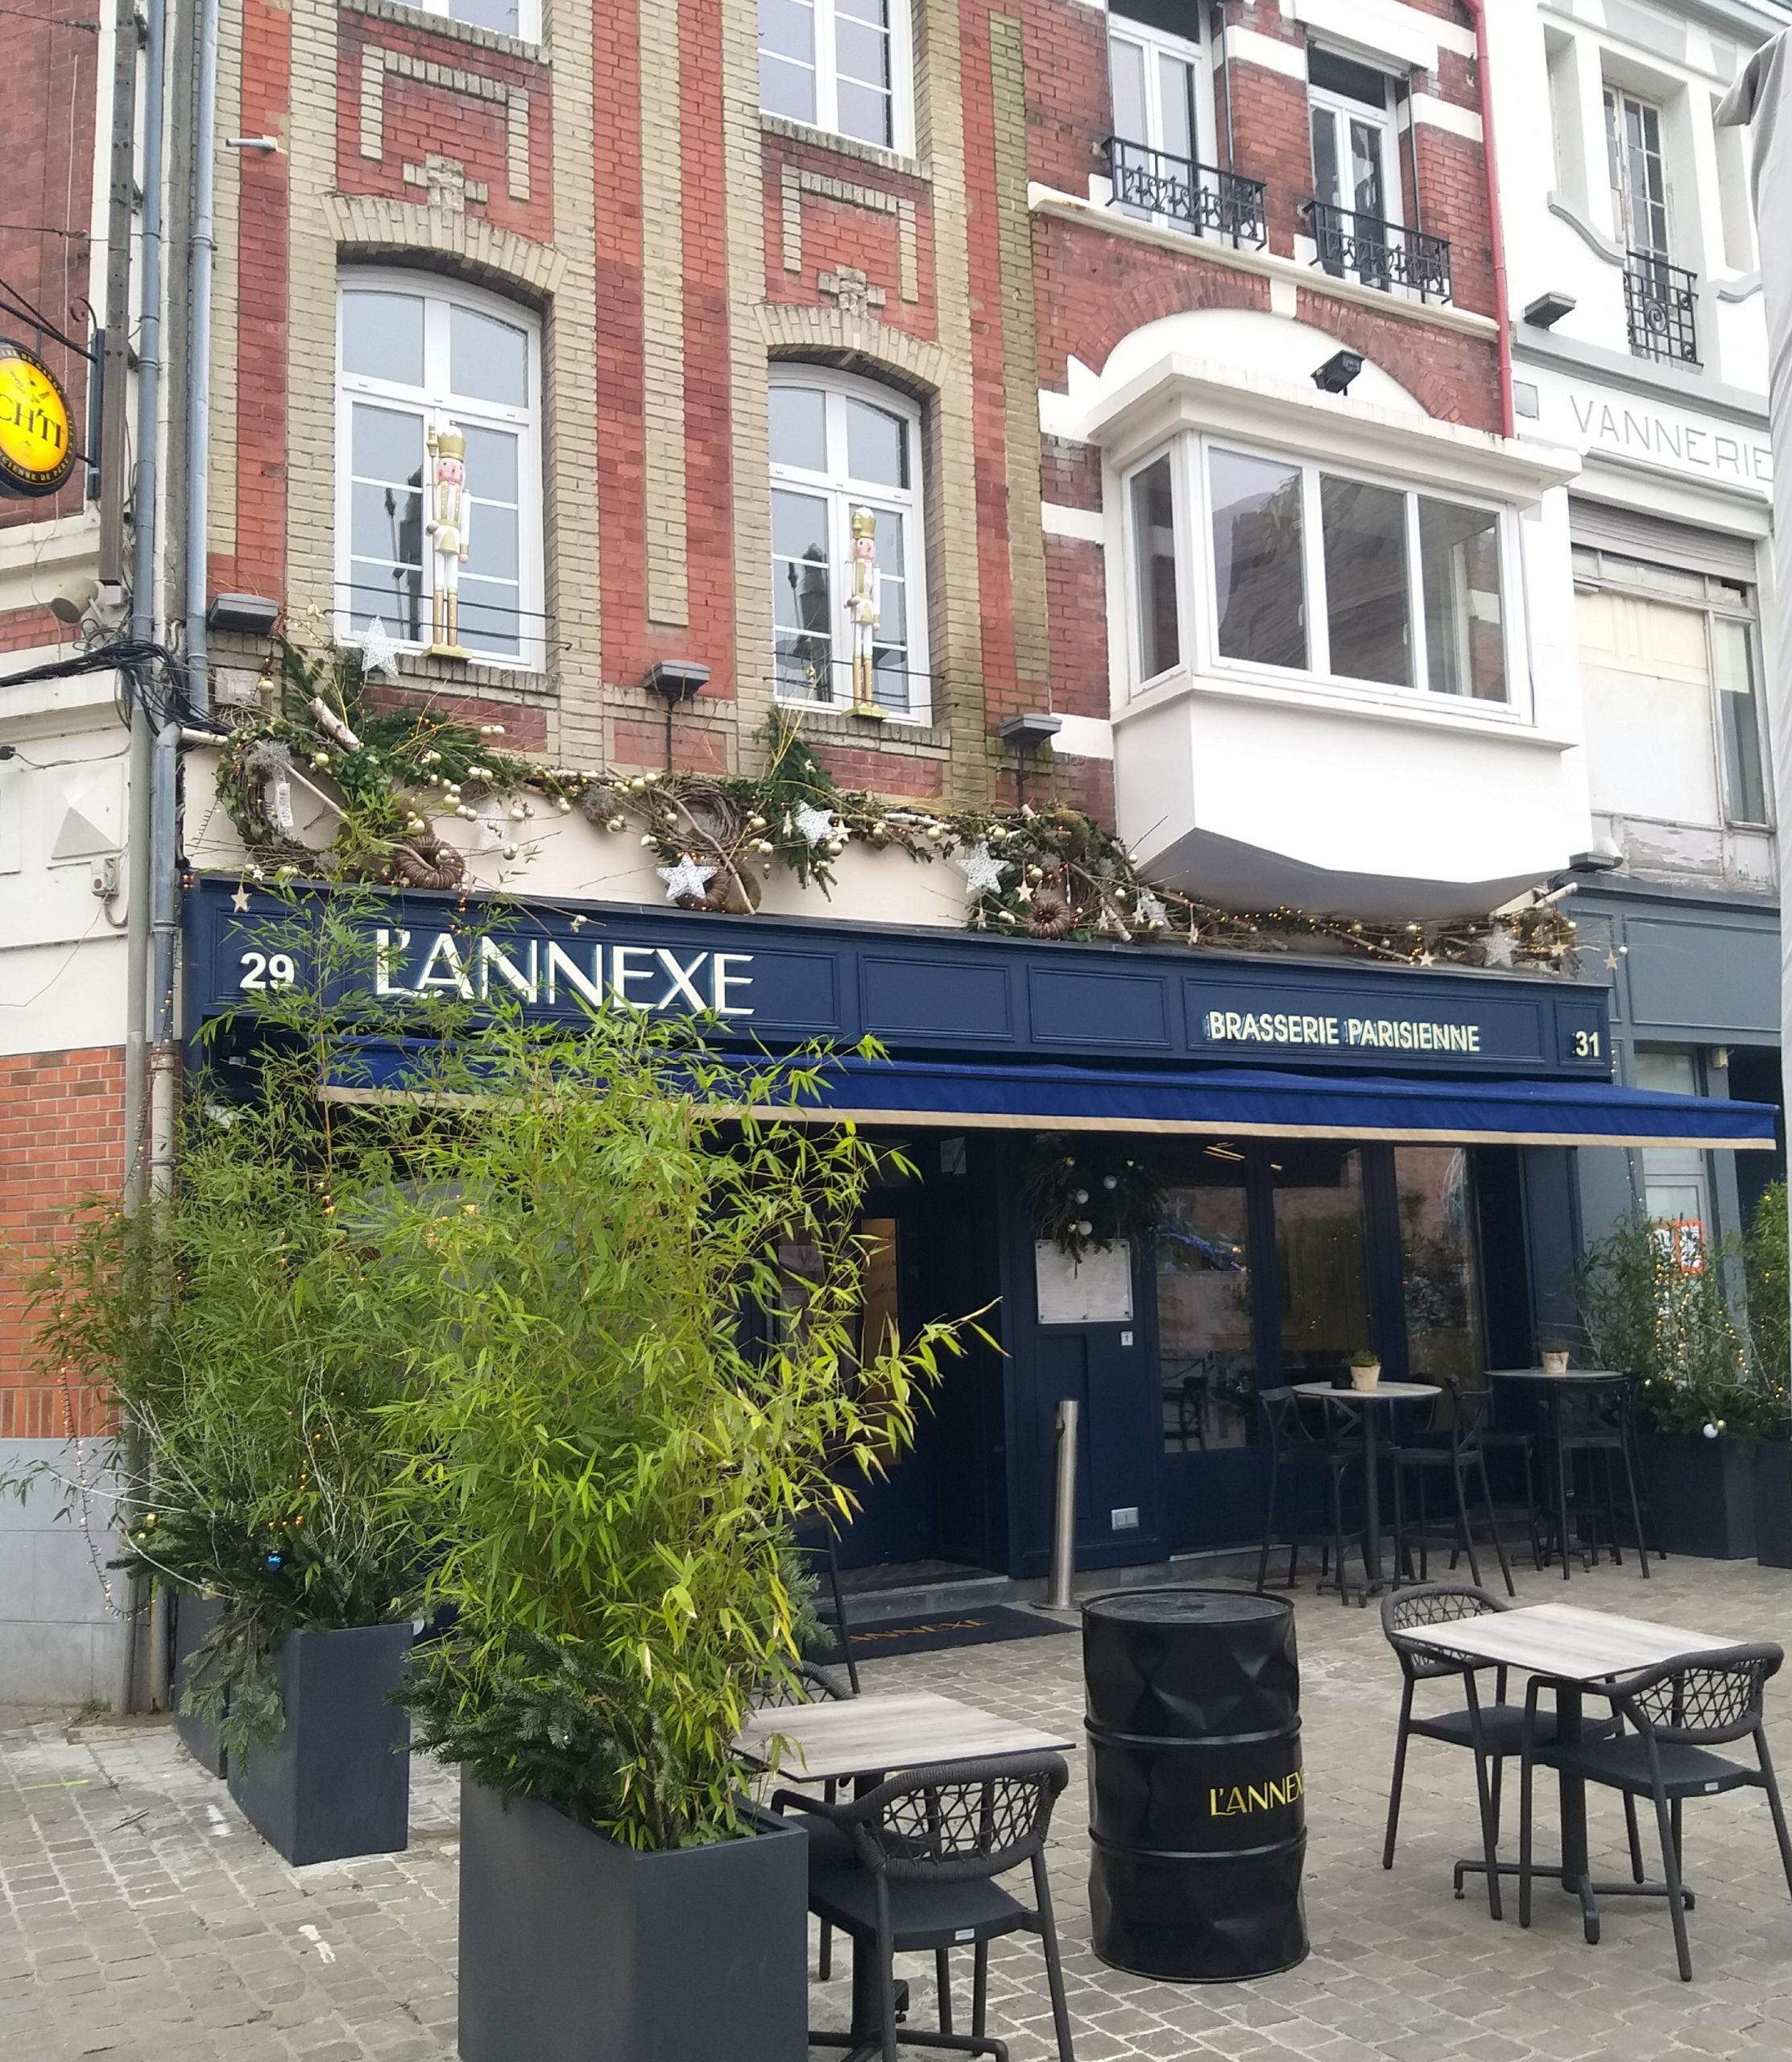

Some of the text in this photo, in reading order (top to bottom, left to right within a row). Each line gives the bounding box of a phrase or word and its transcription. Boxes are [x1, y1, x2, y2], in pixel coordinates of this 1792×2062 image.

[1570, 395, 1773, 482] VANNERIE
[239, 951, 295, 990] 29
[375, 928, 755, 1015] L'ANNEXE
[1207, 1010, 1480, 1052] BRASSERIE PARISIENNE
[1575, 1030, 1600, 1058] 31
[1210, 1770, 1303, 1816] L'ANNEX
